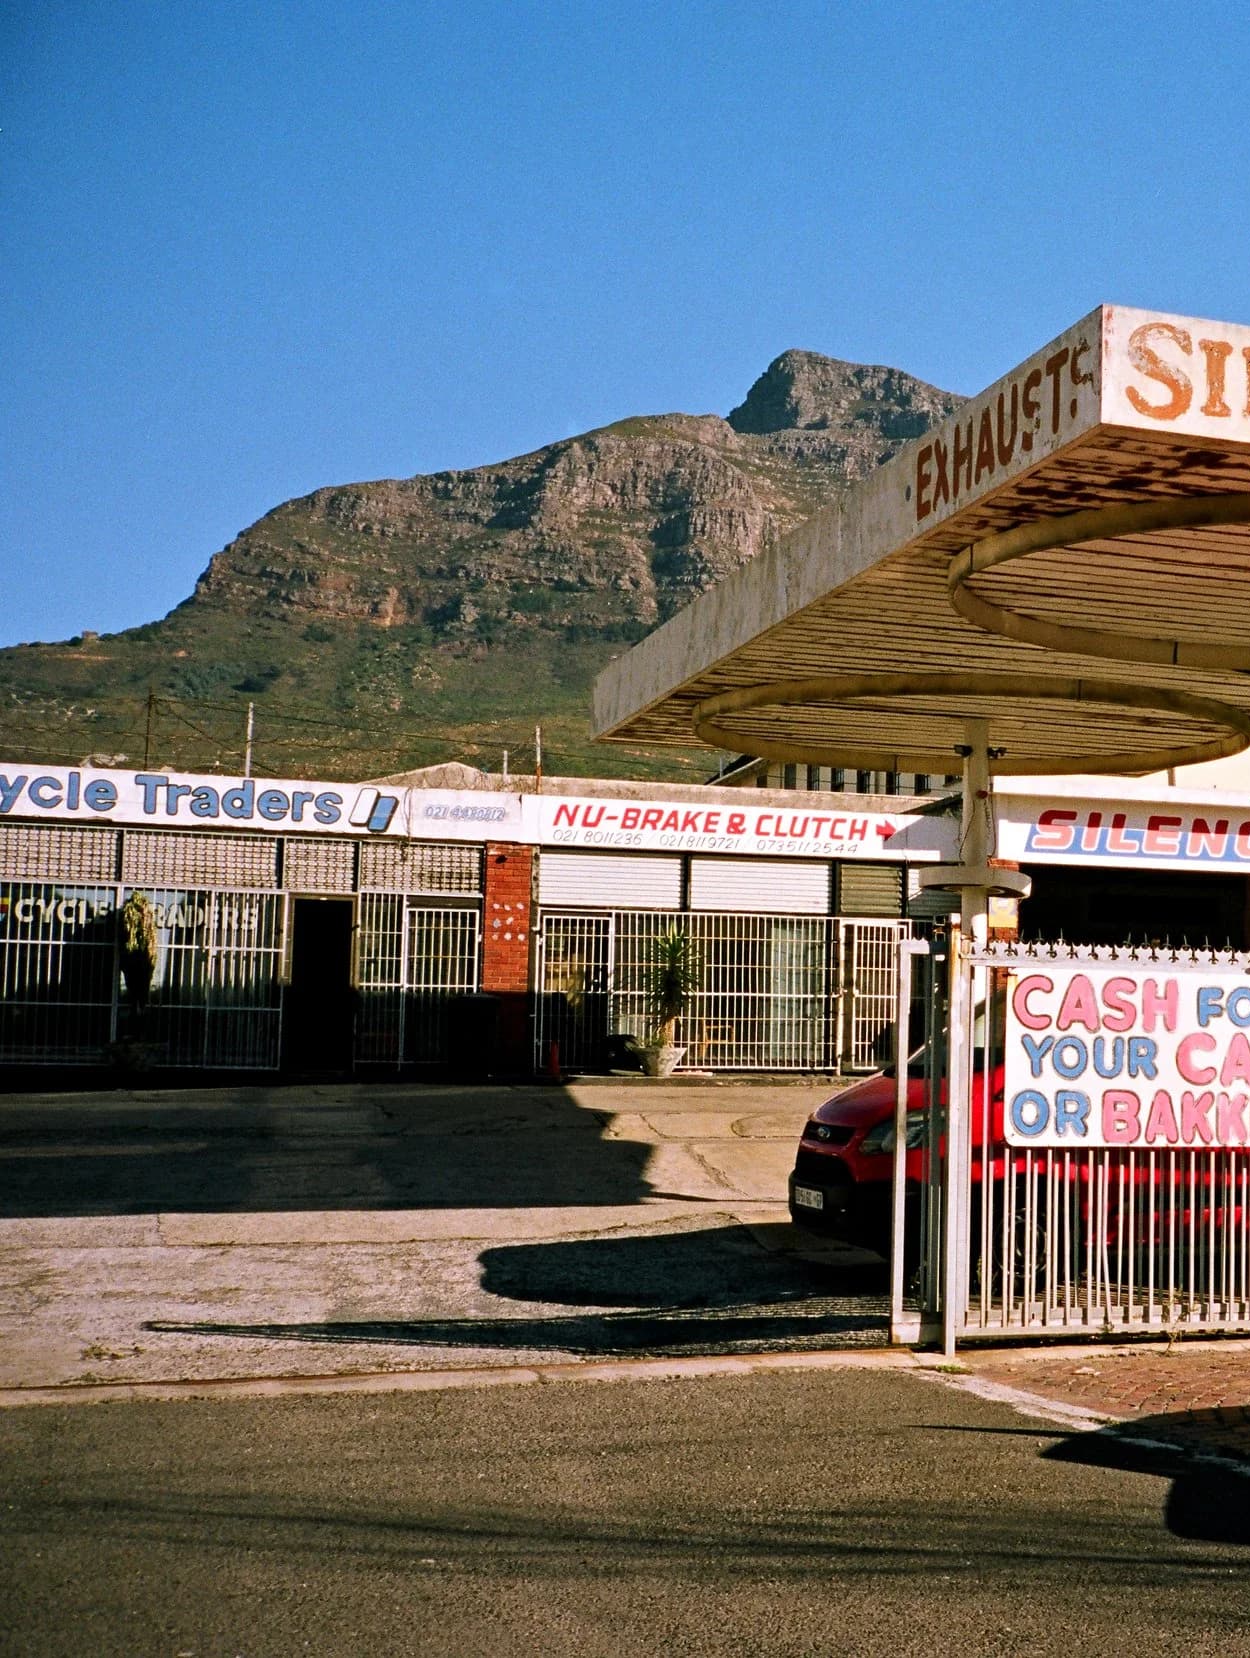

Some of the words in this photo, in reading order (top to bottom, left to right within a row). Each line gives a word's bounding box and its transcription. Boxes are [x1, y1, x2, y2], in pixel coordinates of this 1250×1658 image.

[134, 774, 344, 825] Traders
[552, 803, 721, 834] NU-BRAKE
[754, 814, 869, 841] CLUTCH
[552, 828, 579, 843] 021
[1012, 973, 1179, 1033] CASH
[1021, 1033, 1159, 1080] YOUR
[1010, 1088, 1092, 1137] OR
